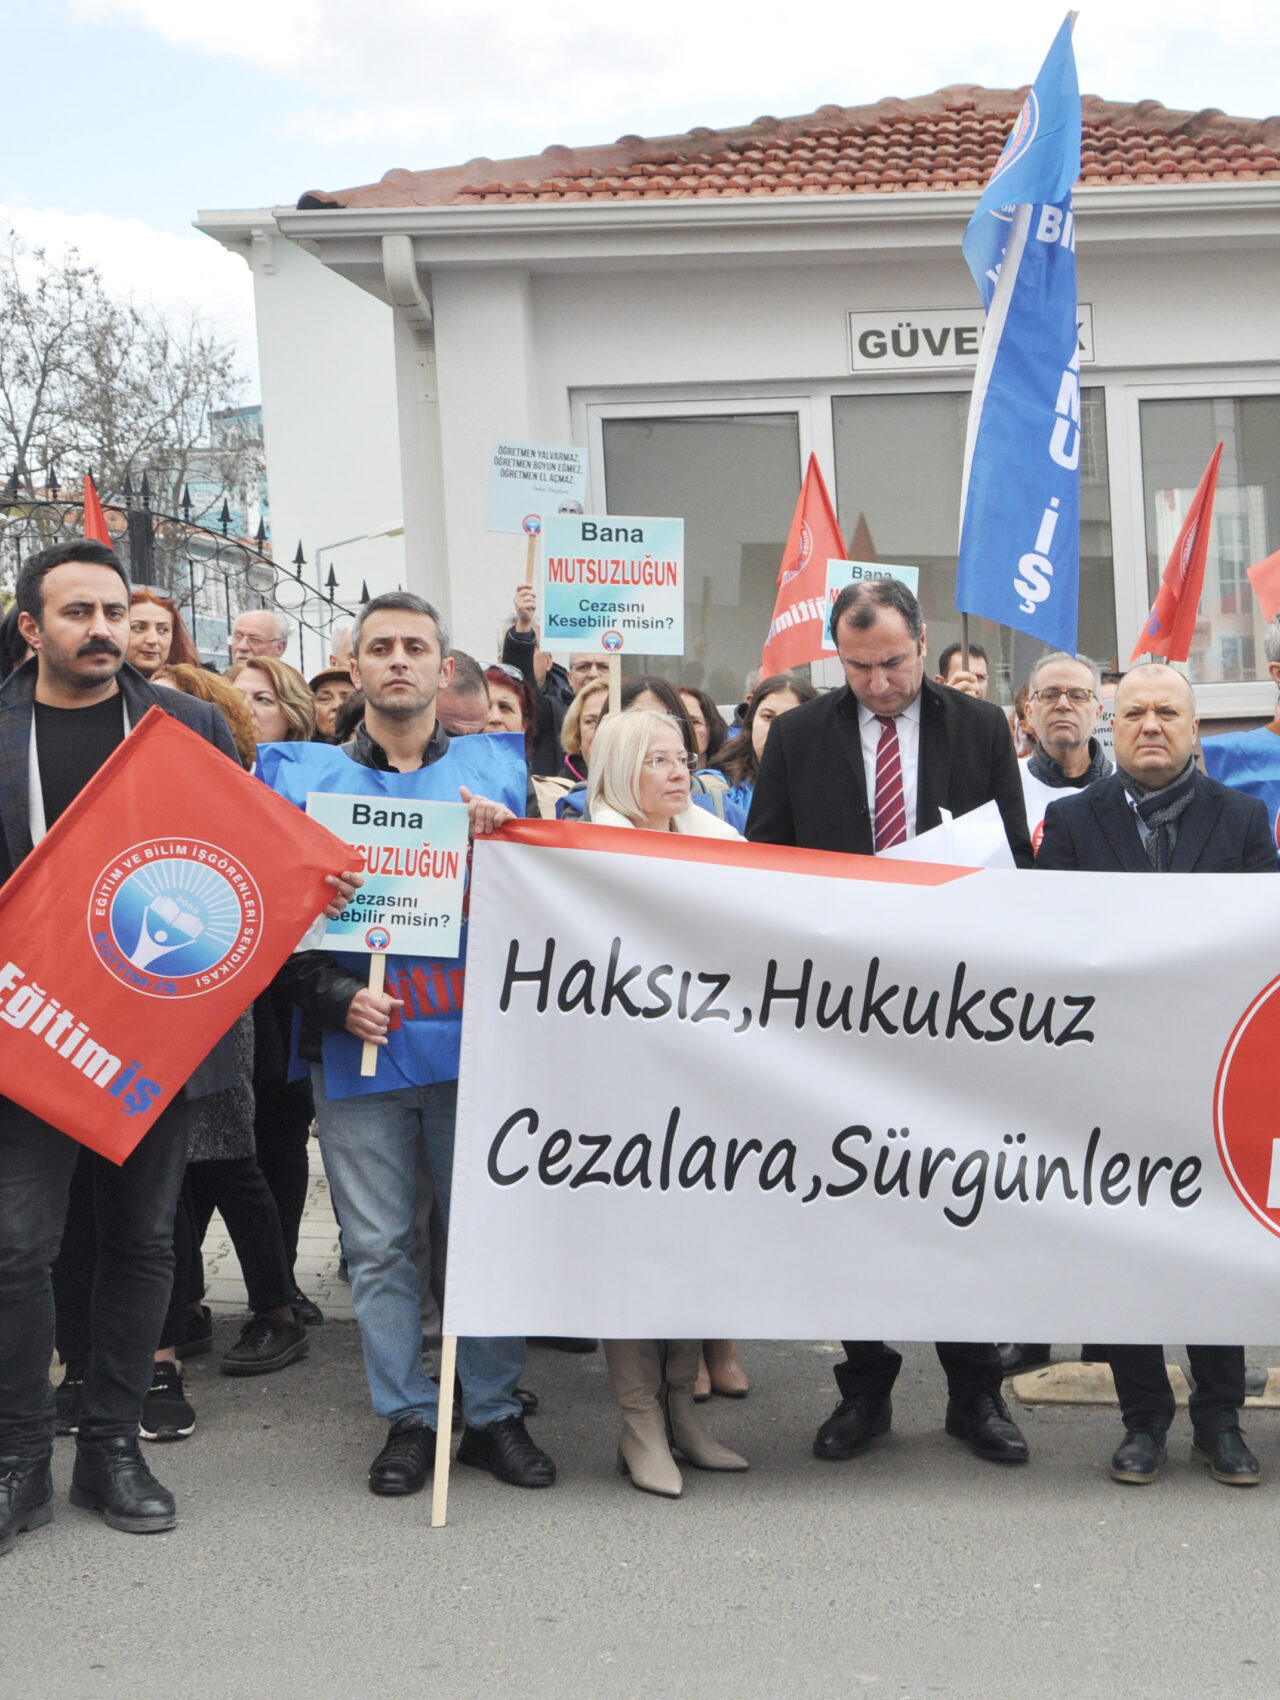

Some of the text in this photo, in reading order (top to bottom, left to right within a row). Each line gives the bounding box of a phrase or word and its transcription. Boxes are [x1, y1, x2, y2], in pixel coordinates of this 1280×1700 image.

[533, 461, 556, 471] BOYUN
[540, 472, 547, 482] EL
[582, 522, 644, 543] Bana
[548, 554, 677, 586] MUTSUZLUĞUN
[579, 599, 645, 613] Cezasını
[549, 614, 674, 630] Kesebilir misin?
[352, 803, 424, 830] Bana
[96, 843, 258, 988] EĞİTİM VE BİLİM İŞGÖRENLERİ SENDİKASI
[329, 909, 450, 928] sebilir misin?
